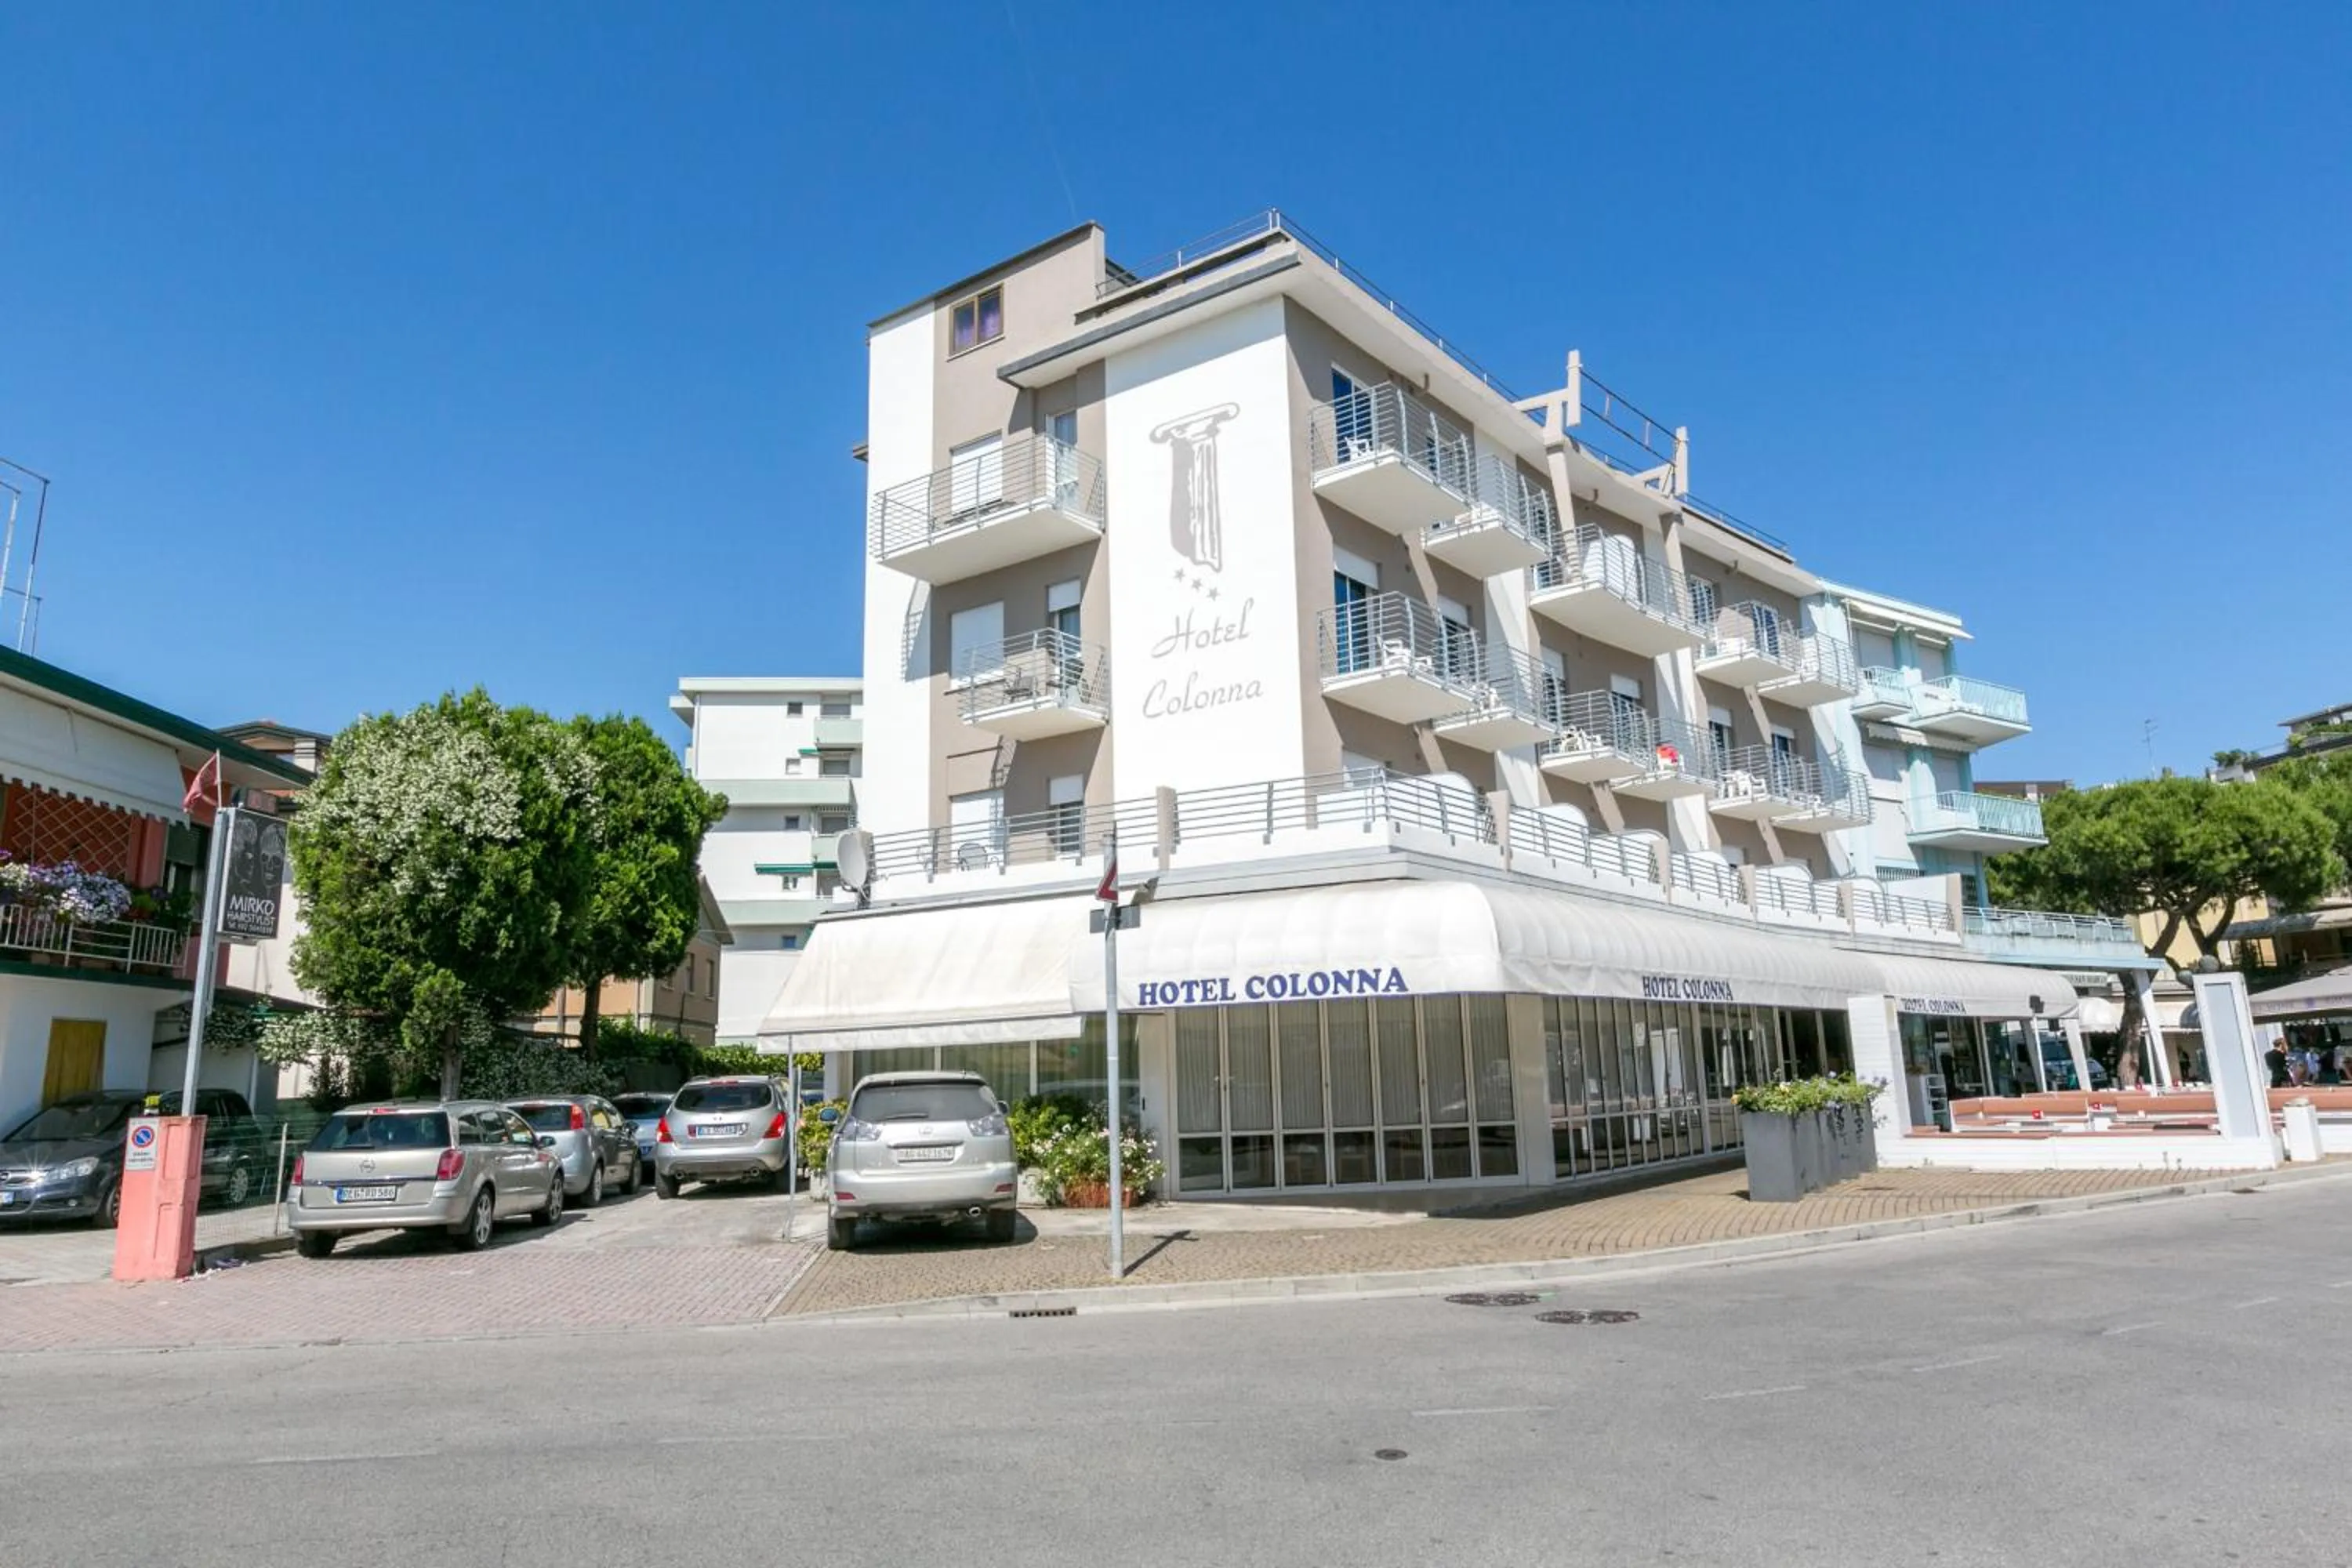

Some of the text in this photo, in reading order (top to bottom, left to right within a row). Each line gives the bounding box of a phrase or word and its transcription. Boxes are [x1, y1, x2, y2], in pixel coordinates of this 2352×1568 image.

[1151, 597, 1254, 658] Hotel
[1143, 670, 1263, 718] Colonna
[230, 895, 274, 916] MIRKO
[1138, 967, 1409, 1005] HOTEL COLONNA
[1642, 976, 1733, 1000] HOTEL COLONNA
